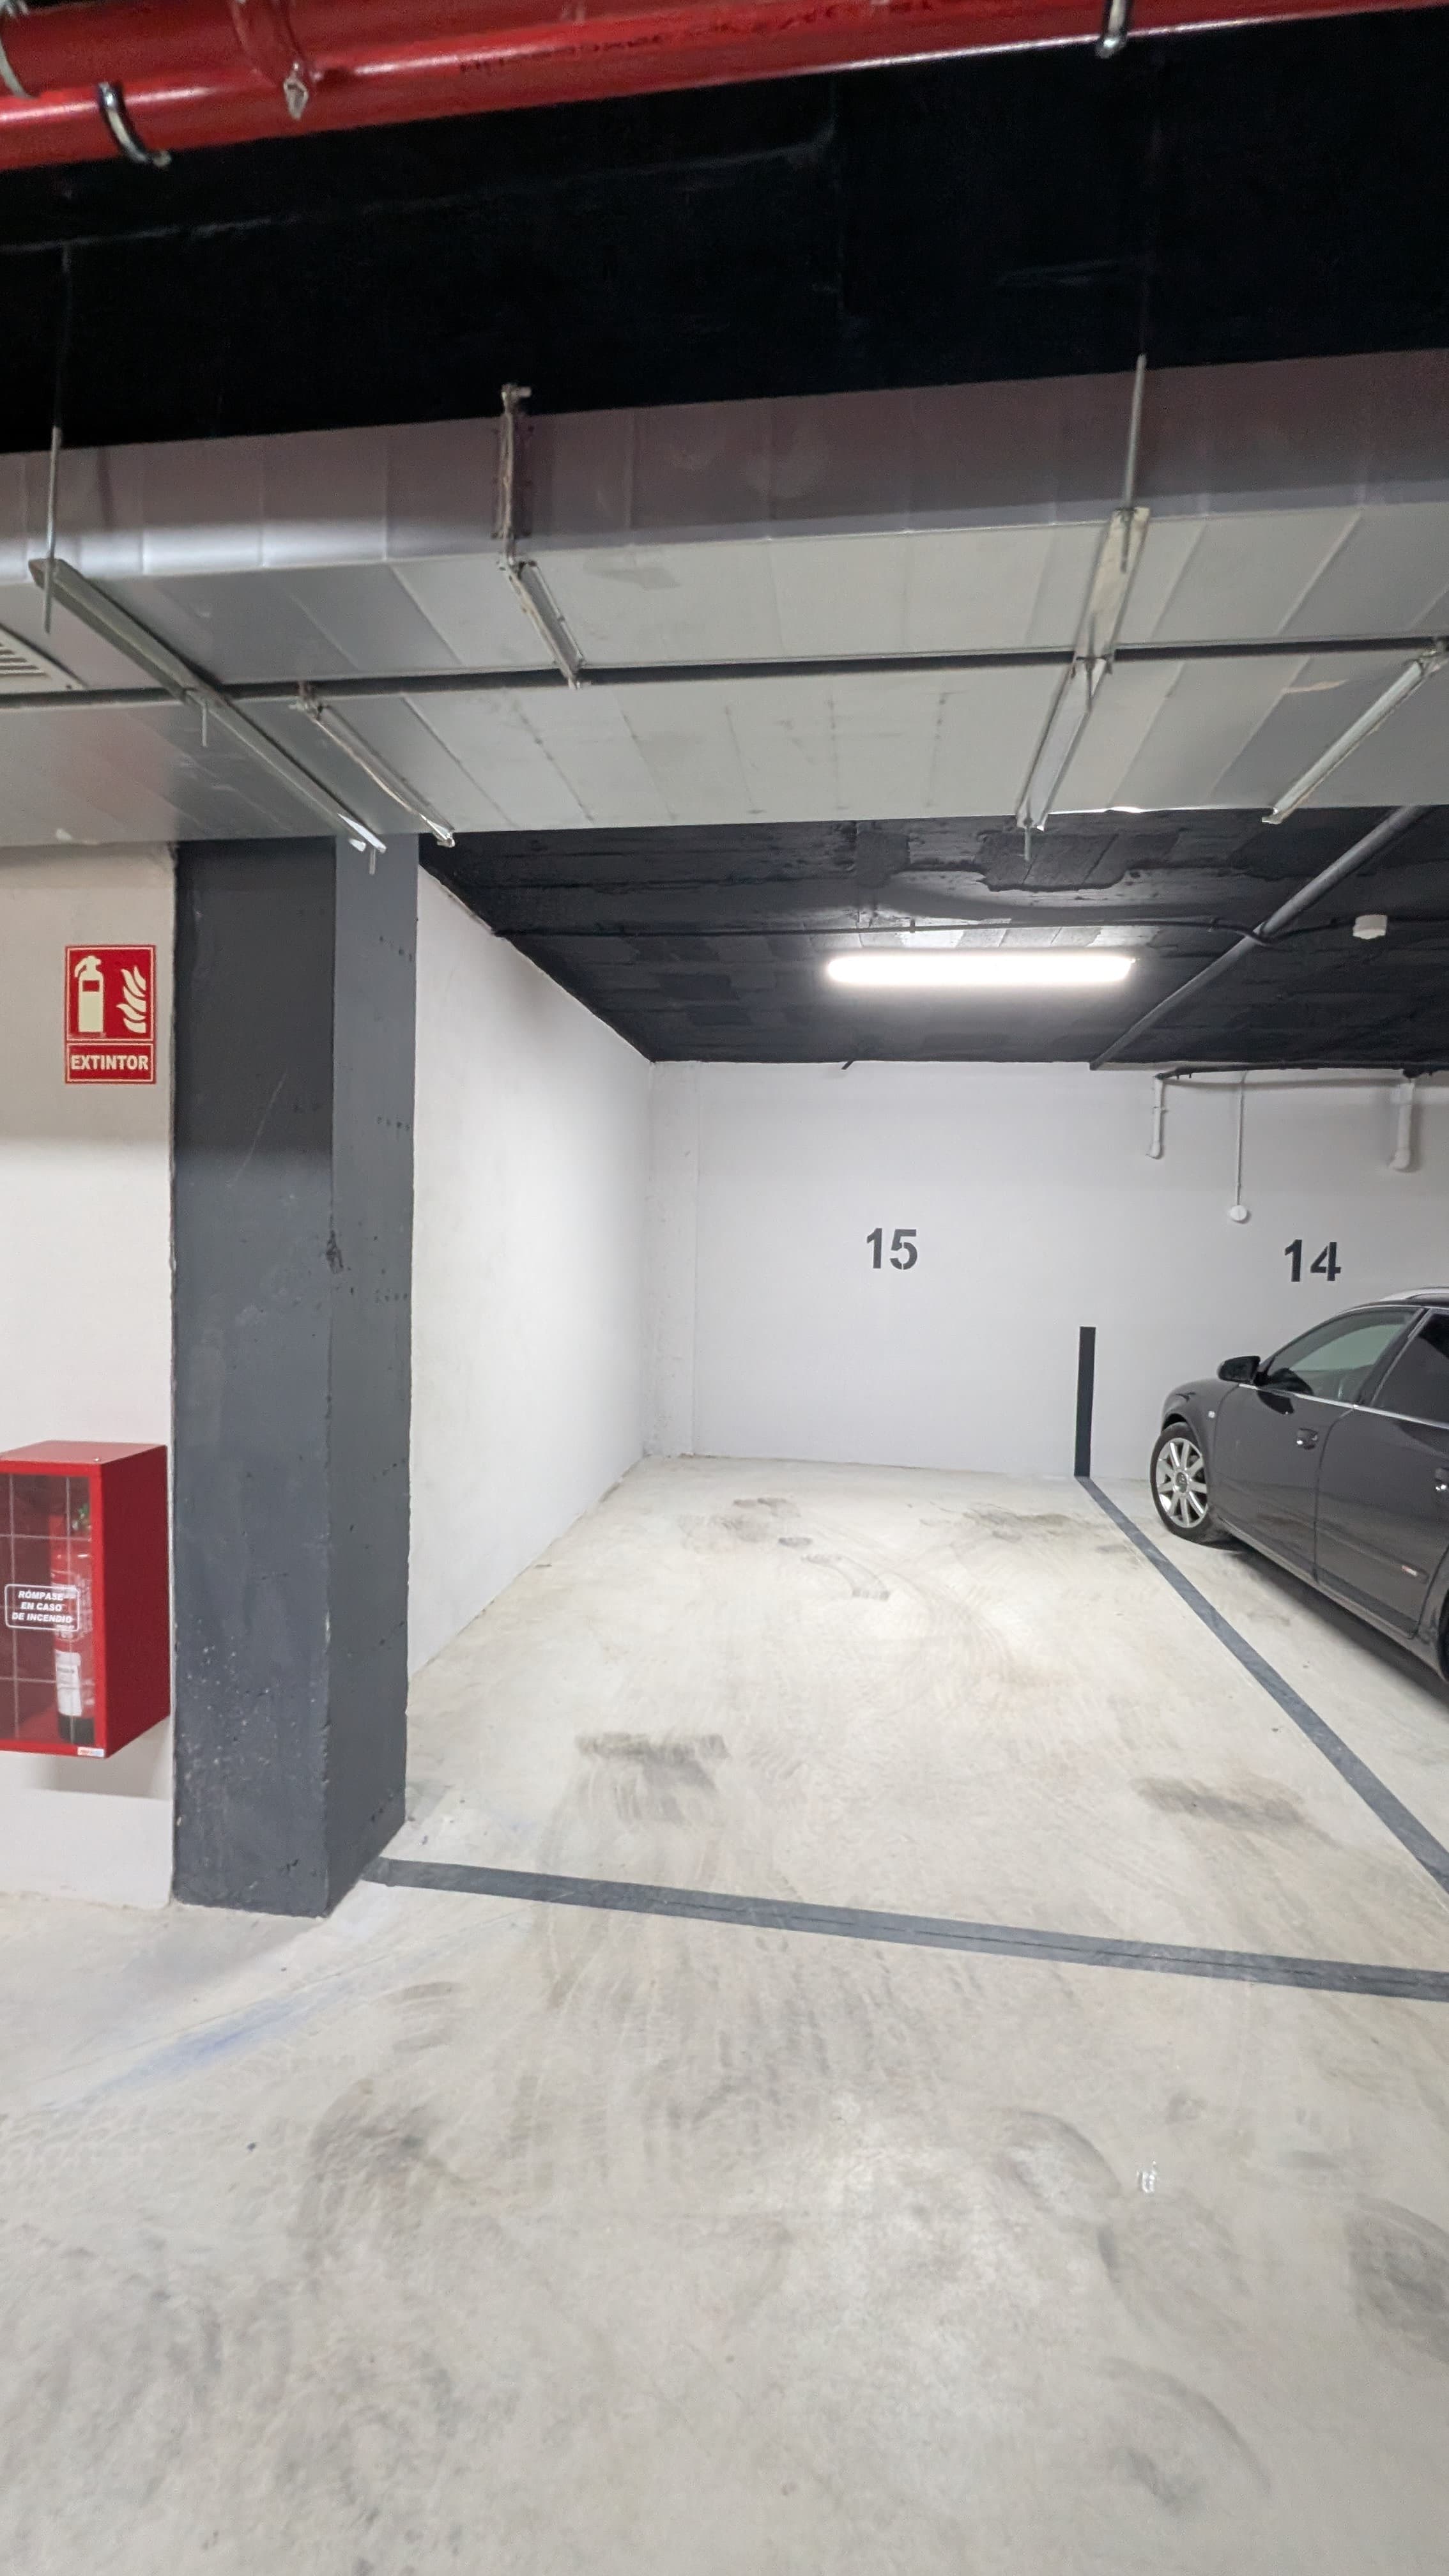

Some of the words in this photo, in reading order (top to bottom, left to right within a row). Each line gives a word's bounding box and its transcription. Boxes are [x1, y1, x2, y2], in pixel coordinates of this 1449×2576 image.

[71, 1055, 149, 1070] EXTINTOR
[867, 1227, 917, 1270] 15
[1284, 1239, 1342, 1282] 14
[20, 1602, 34, 1610] EN
[36, 1602, 62, 1612] CASO
[12, 1612, 25, 1620] DE
[26, 1613, 73, 1623] INCENDIO
